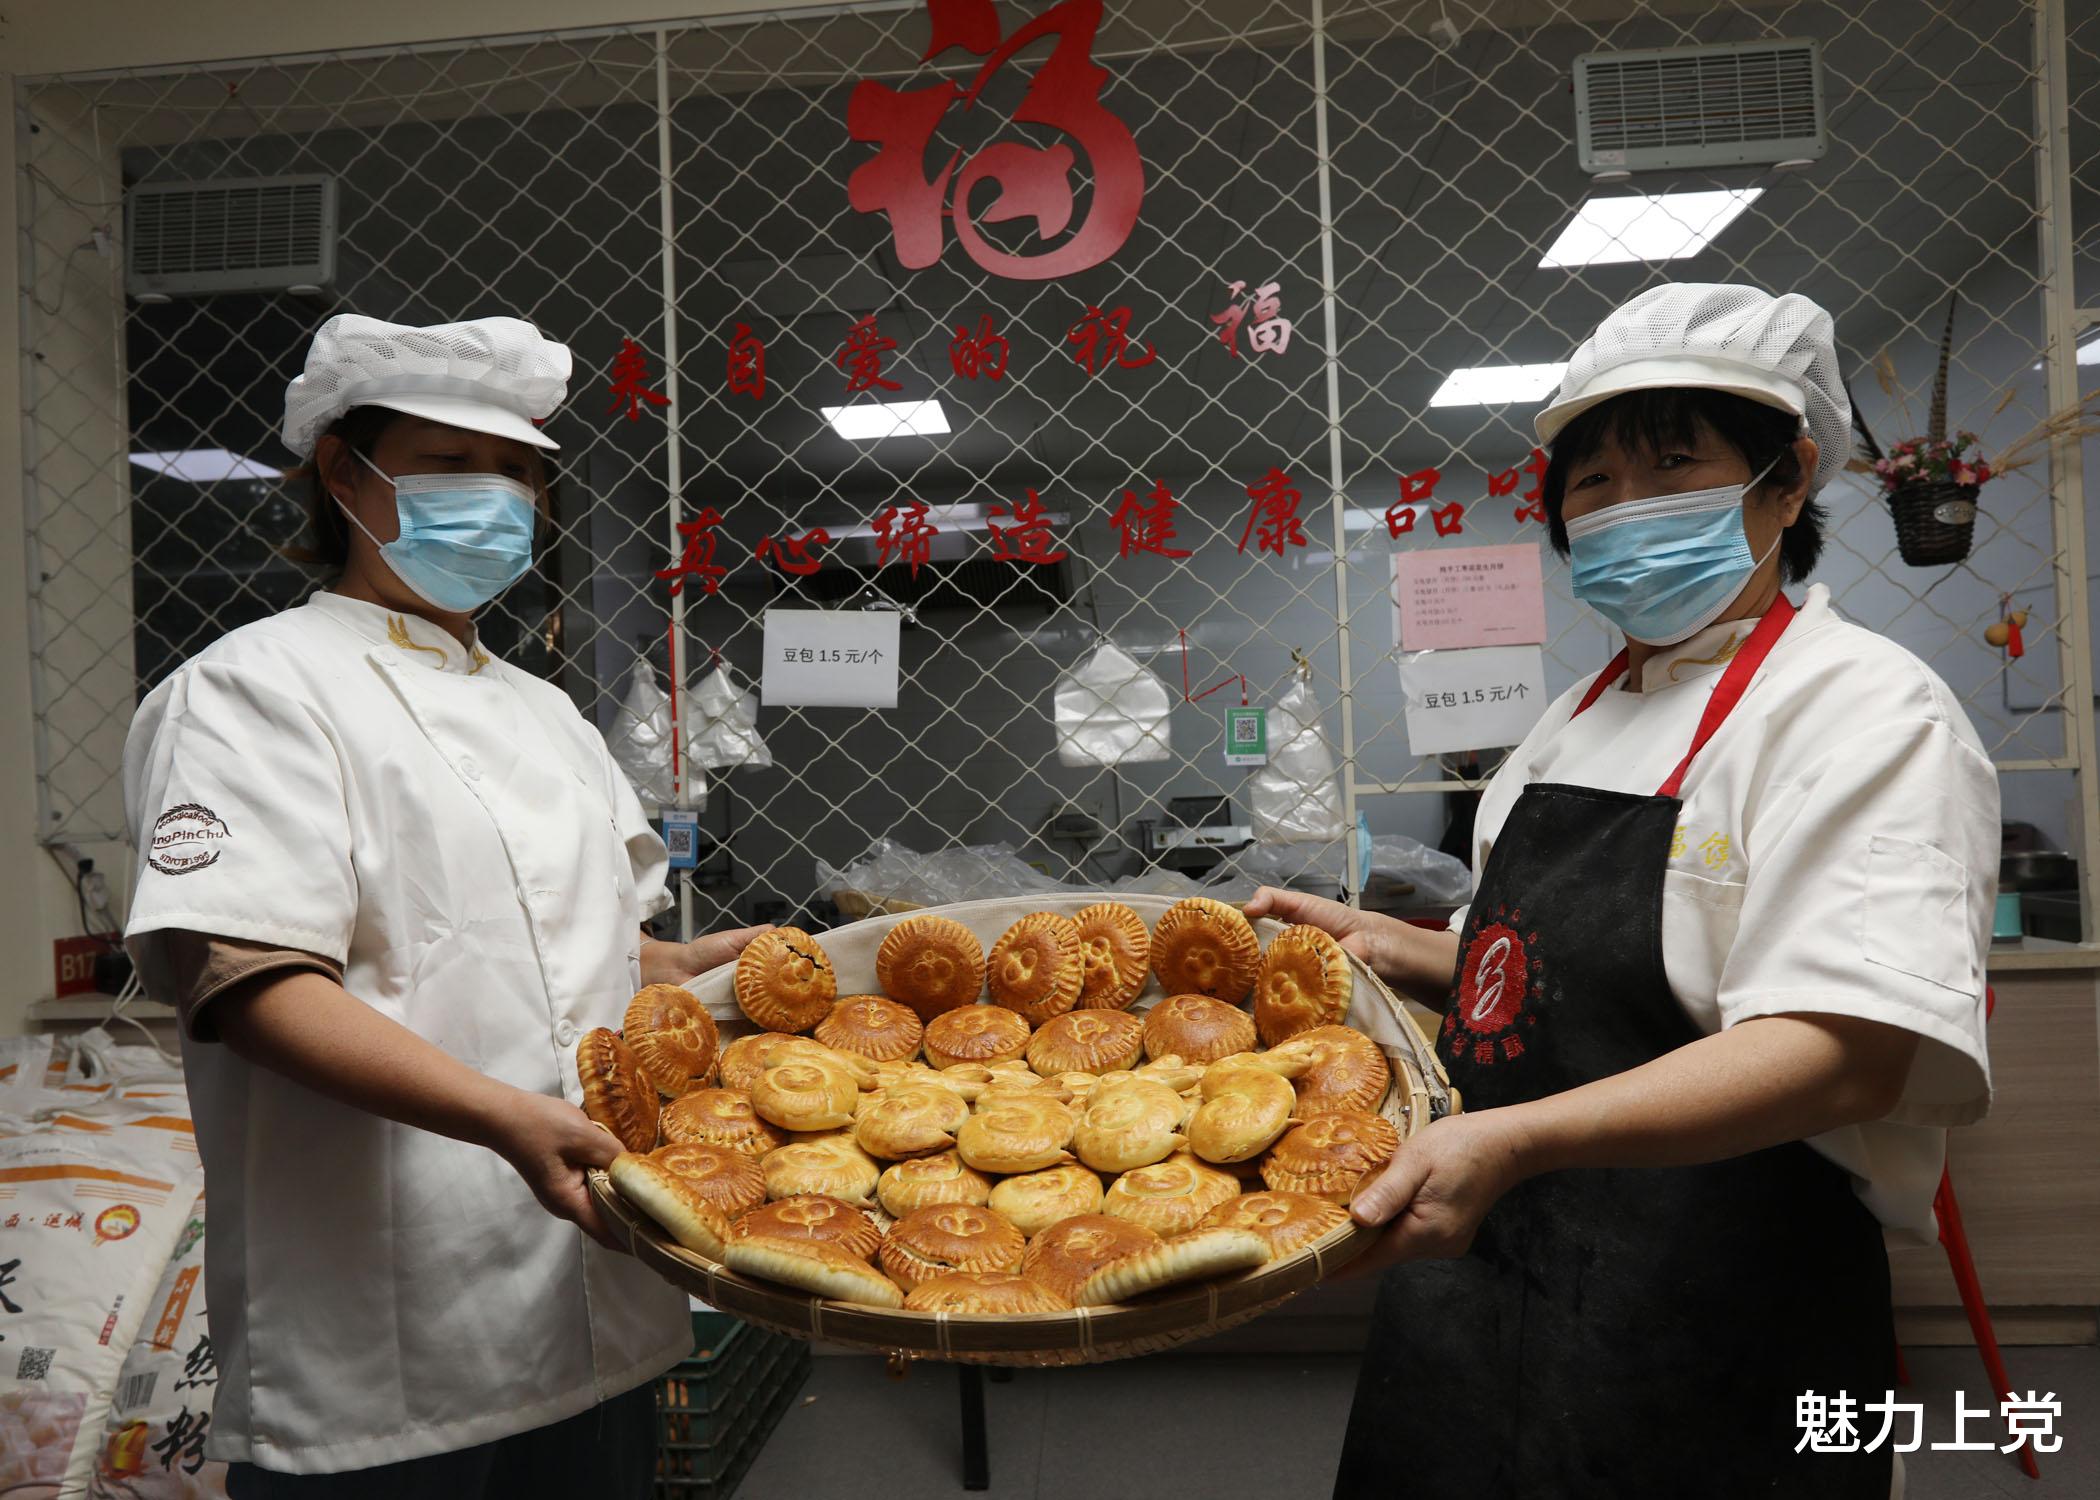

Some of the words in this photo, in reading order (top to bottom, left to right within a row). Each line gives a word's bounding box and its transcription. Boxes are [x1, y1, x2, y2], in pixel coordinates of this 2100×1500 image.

[607, 281, 1291, 421] 来自爱的祝福
[655, 448, 1550, 597] 真心缔造健康品味
[783, 648, 813, 663] 豆包
[819, 650, 841, 662] 1.5
[845, 648, 883, 664] 元/个
[1425, 692, 1457, 709] 豆包
[1462, 689, 1485, 704] 1.5
[1490, 683, 1529, 702] 元/个
[61, 953, 97, 983] B17
